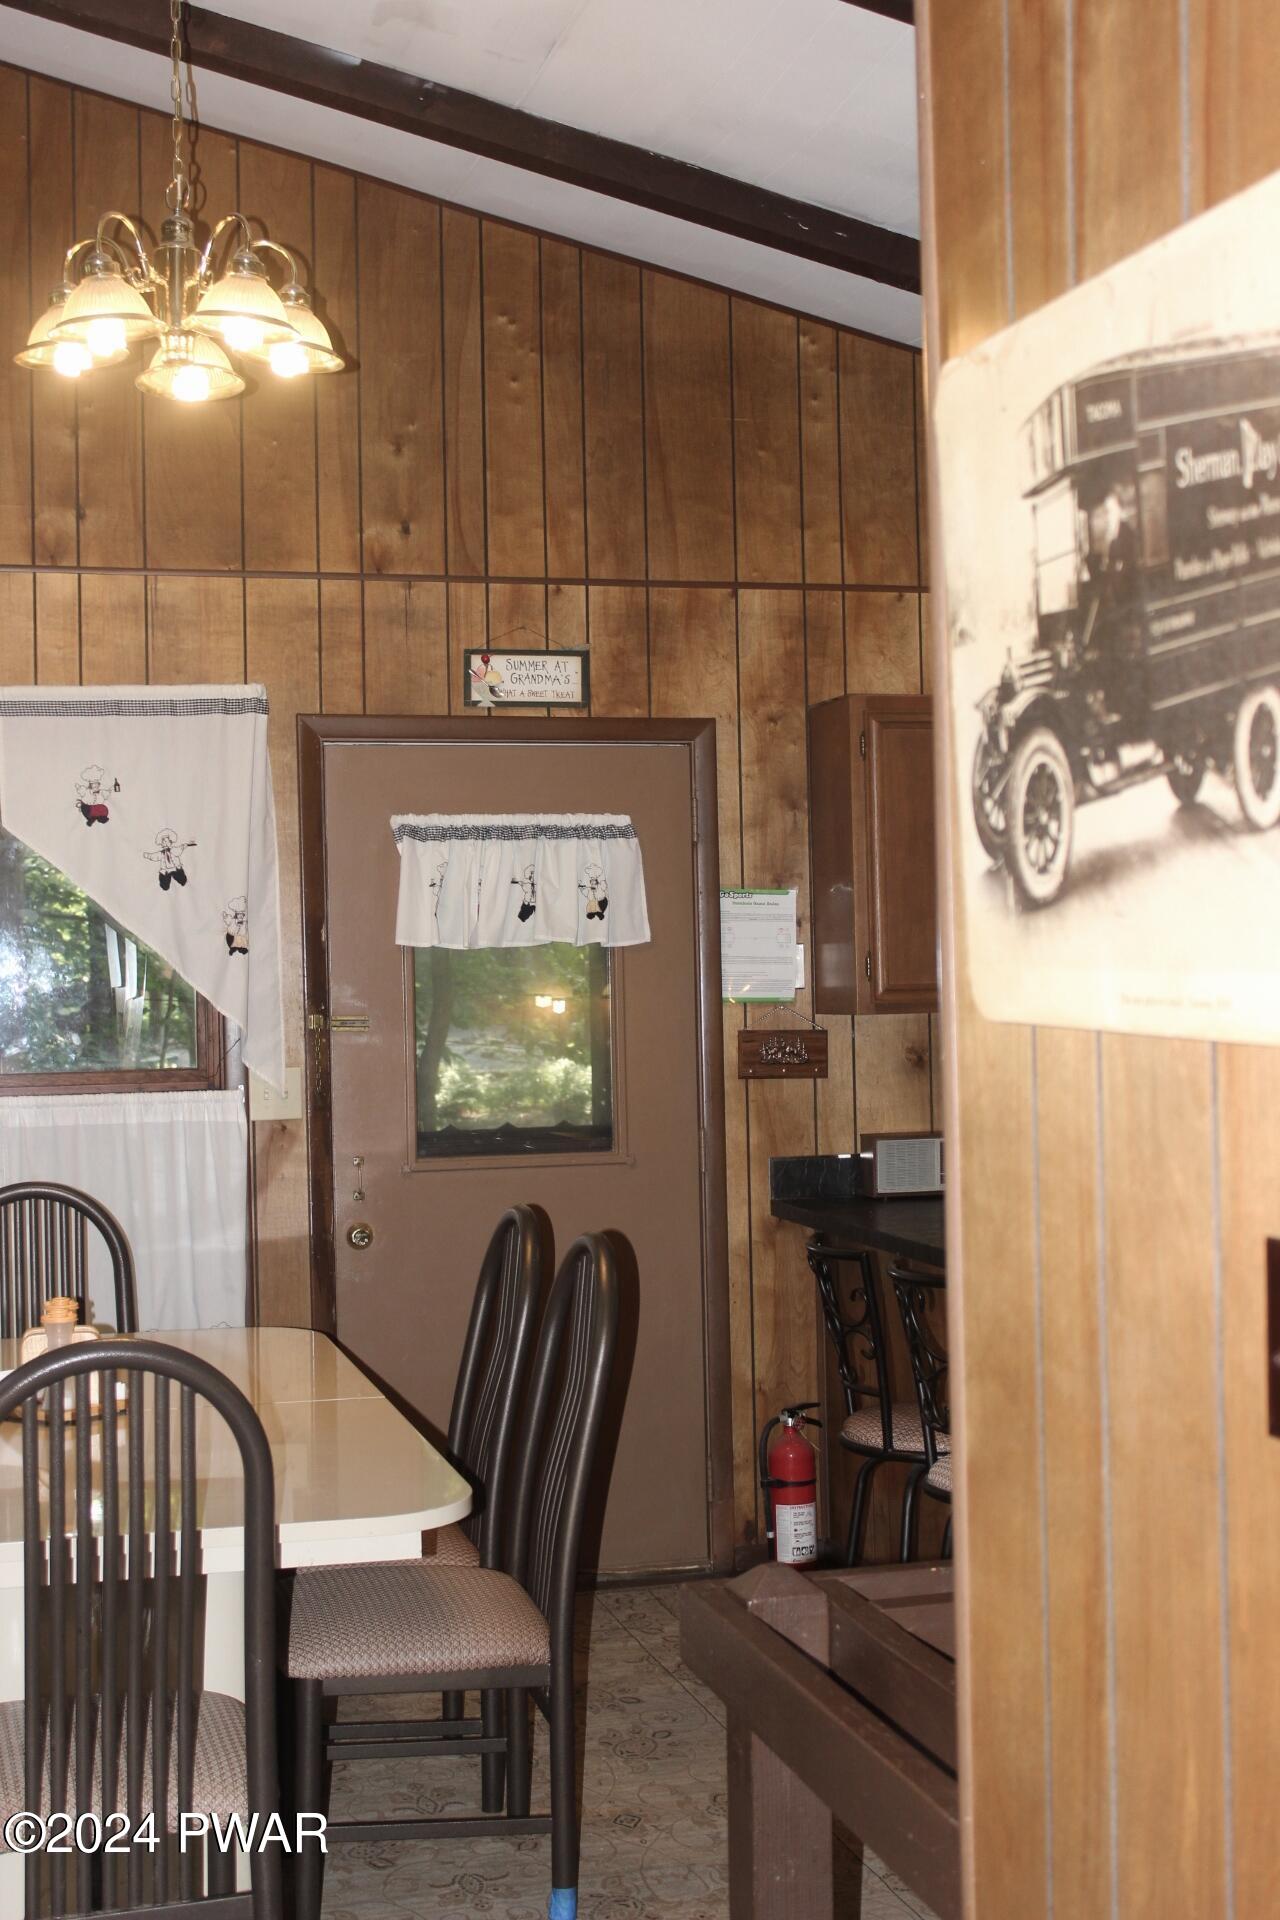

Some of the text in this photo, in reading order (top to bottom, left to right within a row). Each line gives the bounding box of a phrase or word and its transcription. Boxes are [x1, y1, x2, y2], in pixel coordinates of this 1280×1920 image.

[505, 659, 569, 674] SUMMER AT
[511, 672, 570, 686] GRANDMA'S
[552, 690, 575, 698] TREAT
